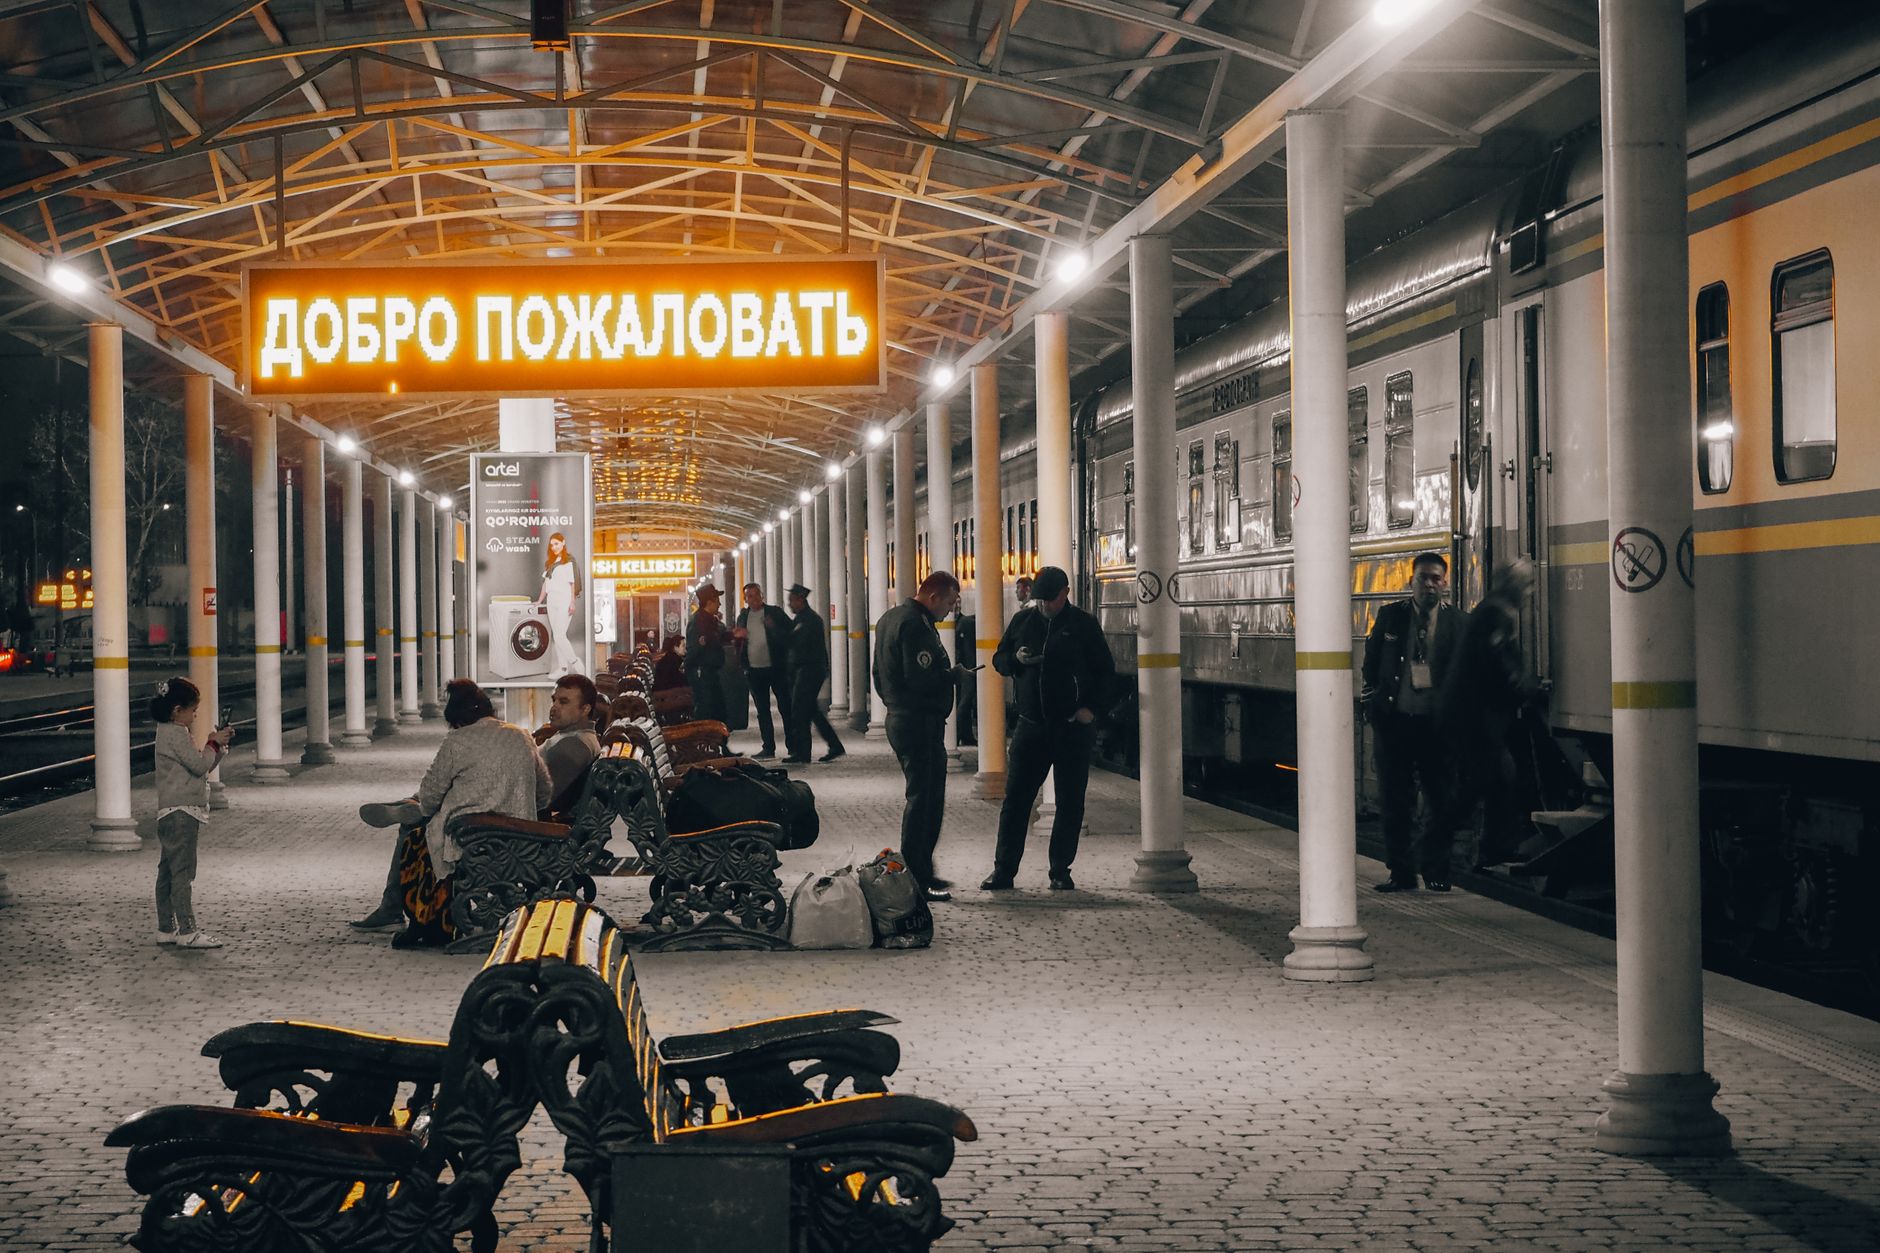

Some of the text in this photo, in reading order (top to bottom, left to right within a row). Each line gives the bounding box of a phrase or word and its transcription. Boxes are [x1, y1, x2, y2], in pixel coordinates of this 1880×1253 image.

[260, 291, 868, 377] ДОБРО ПОЖАЛОВАТЬ
[485, 461, 520, 476] artel
[505, 545, 530, 553] wash
[621, 559, 692, 574] KELIBSIZ
